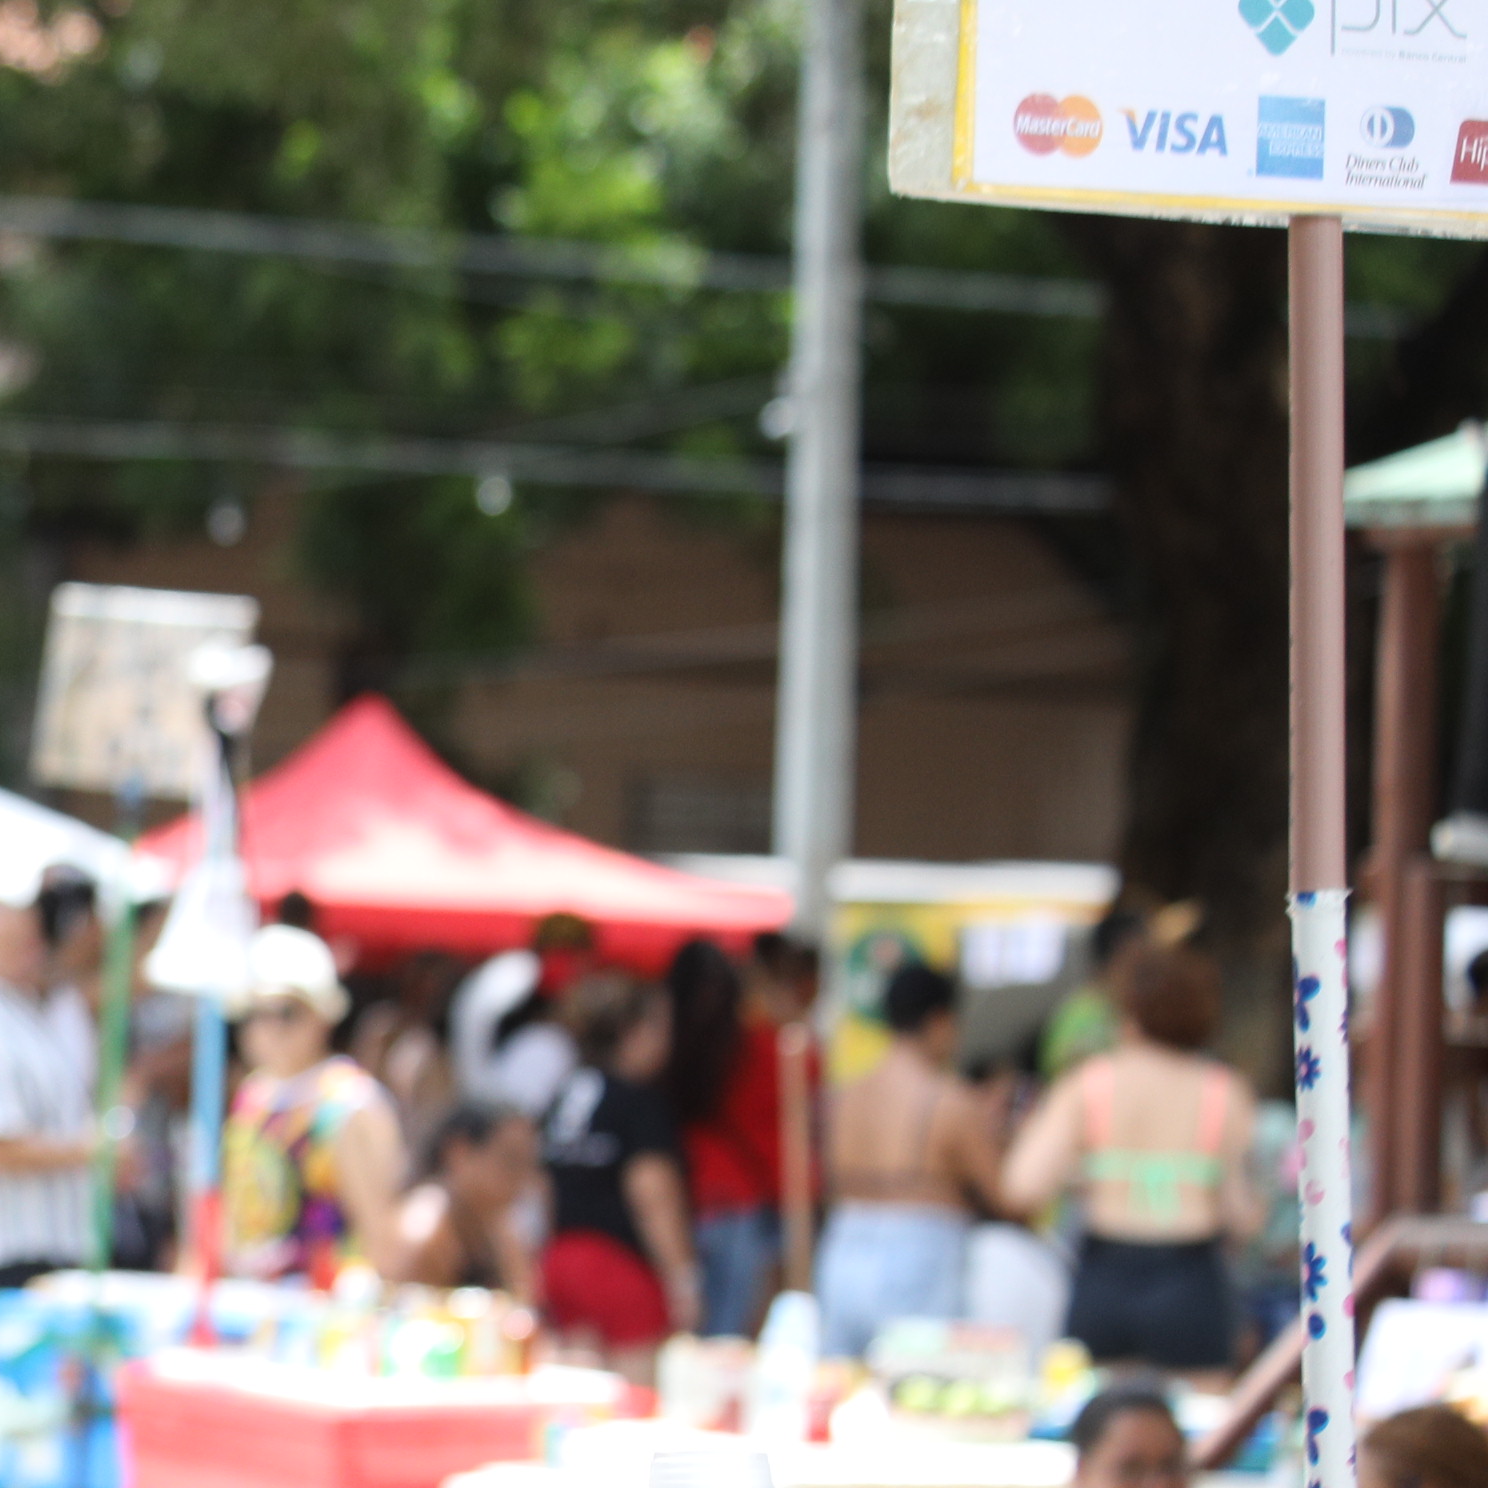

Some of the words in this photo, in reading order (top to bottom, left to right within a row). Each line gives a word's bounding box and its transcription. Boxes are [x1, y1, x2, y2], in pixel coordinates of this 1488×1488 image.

[1016, 114, 1102, 139] MasterCard
[1120, 108, 1228, 157] VISA
[1345, 153, 1386, 172] Diners
[1387, 156, 1420, 173] Club
[1344, 170, 1427, 190] International
